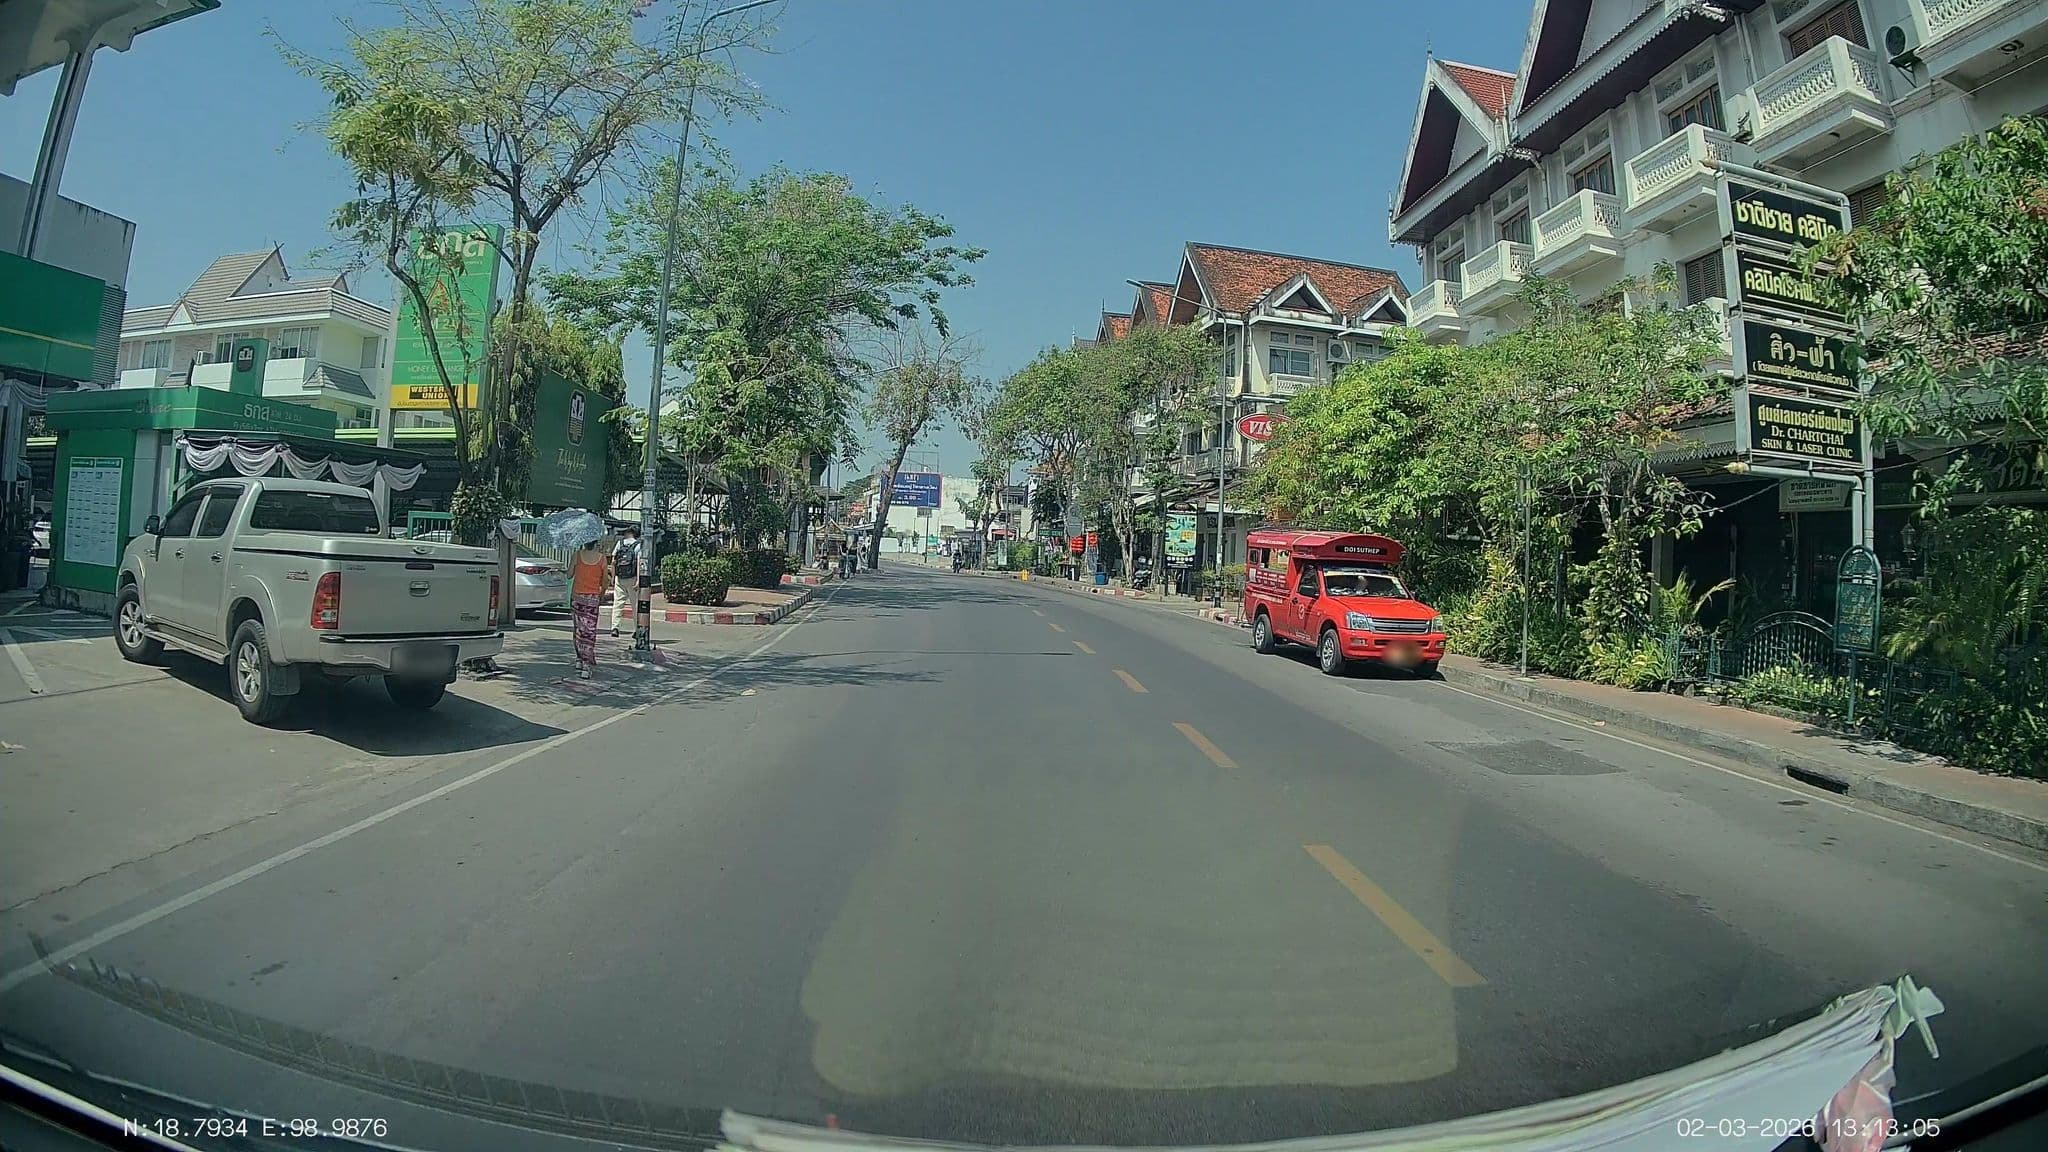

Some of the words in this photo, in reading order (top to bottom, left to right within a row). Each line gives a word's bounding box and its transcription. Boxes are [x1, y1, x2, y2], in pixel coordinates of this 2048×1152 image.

[1737, 200, 1794, 234] ชาติชาย
[243, 403, 270, 422] ธกส
[1787, 427, 1845, 446] CHARTCHAI
[1761, 438, 1783, 450] SKIN
[1785, 441, 1794, 451] &
[1796, 442, 1824, 455] LASER
[1826, 446, 1854, 459] CLINIC
[1356, 547, 1380, 555] SUTHEP
